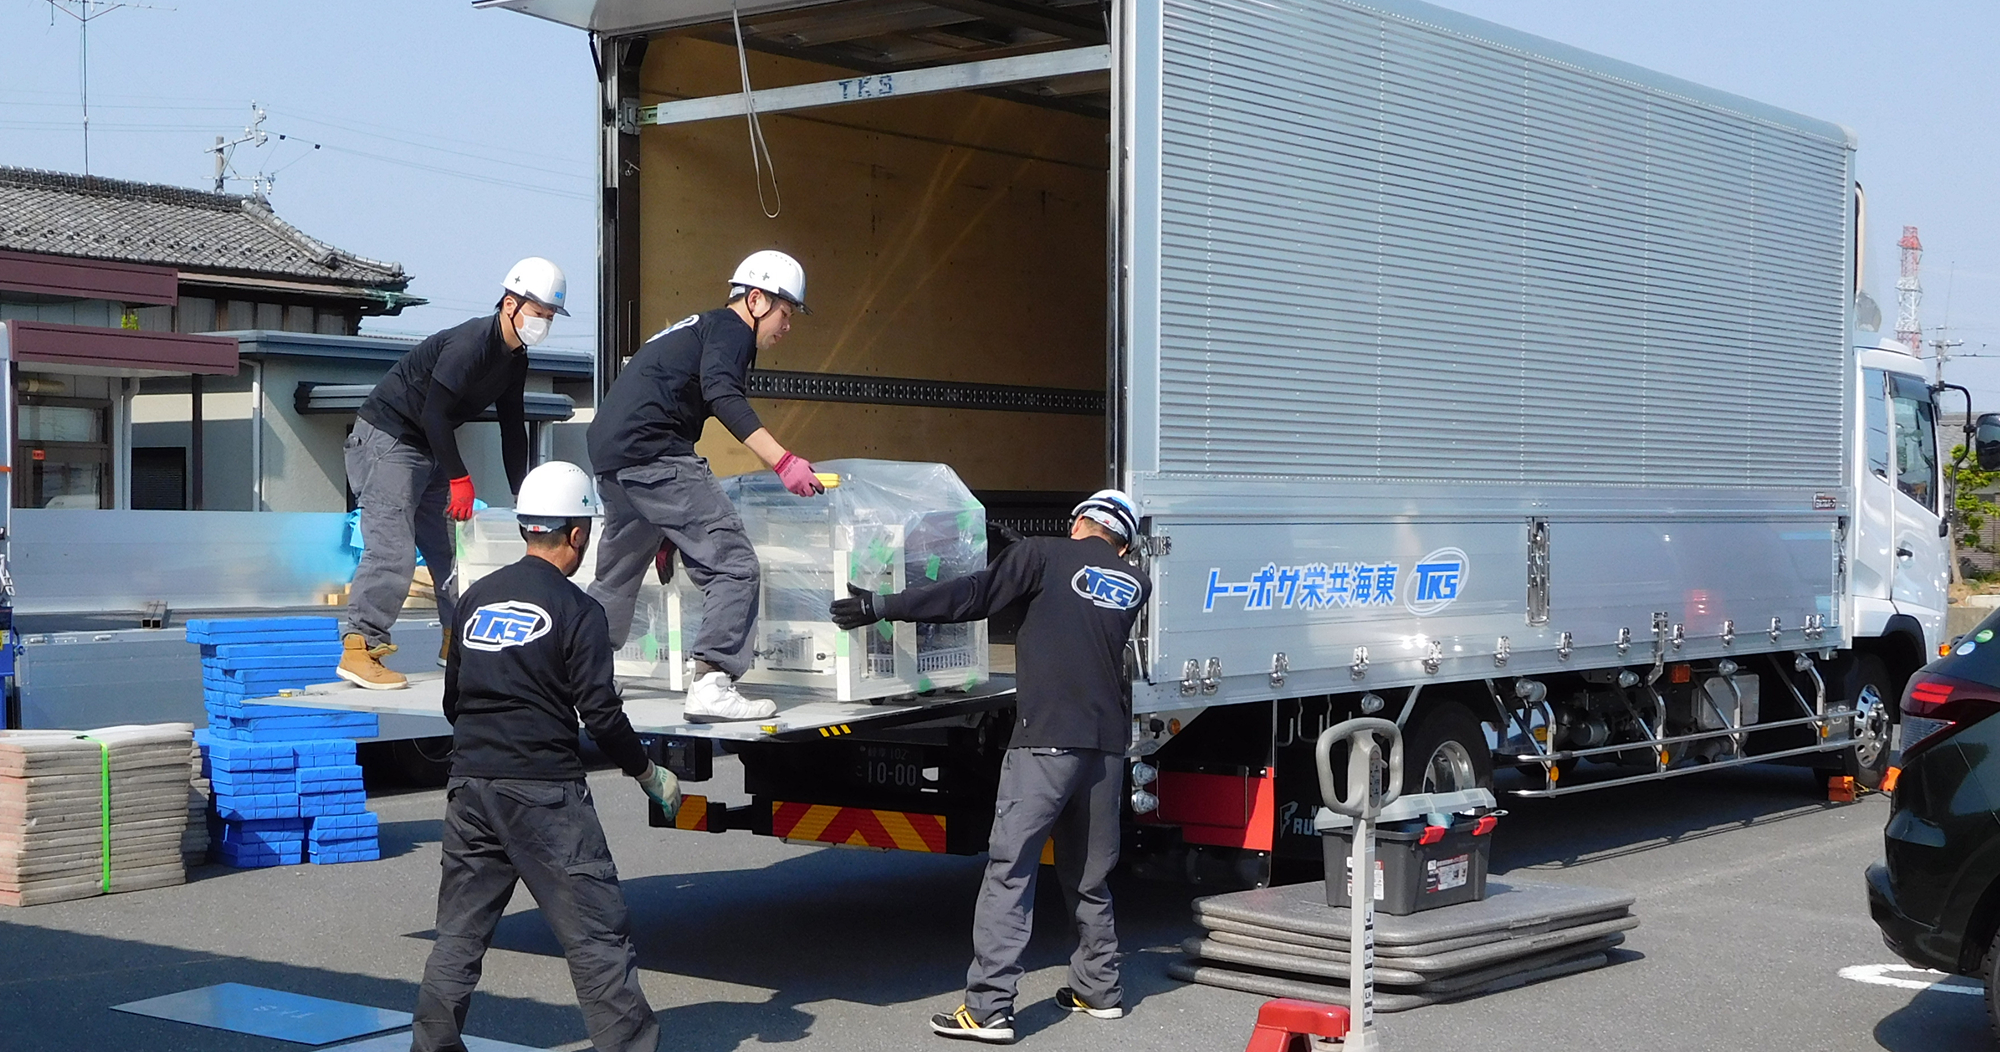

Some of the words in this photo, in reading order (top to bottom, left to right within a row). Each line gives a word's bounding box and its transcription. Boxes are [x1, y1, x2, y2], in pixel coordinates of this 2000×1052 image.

[838, 75, 893, 99] TKS
[1084, 566, 1137, 609] TKS
[1415, 561, 1461, 602] TKS
[470, 608, 540, 646] TKS
